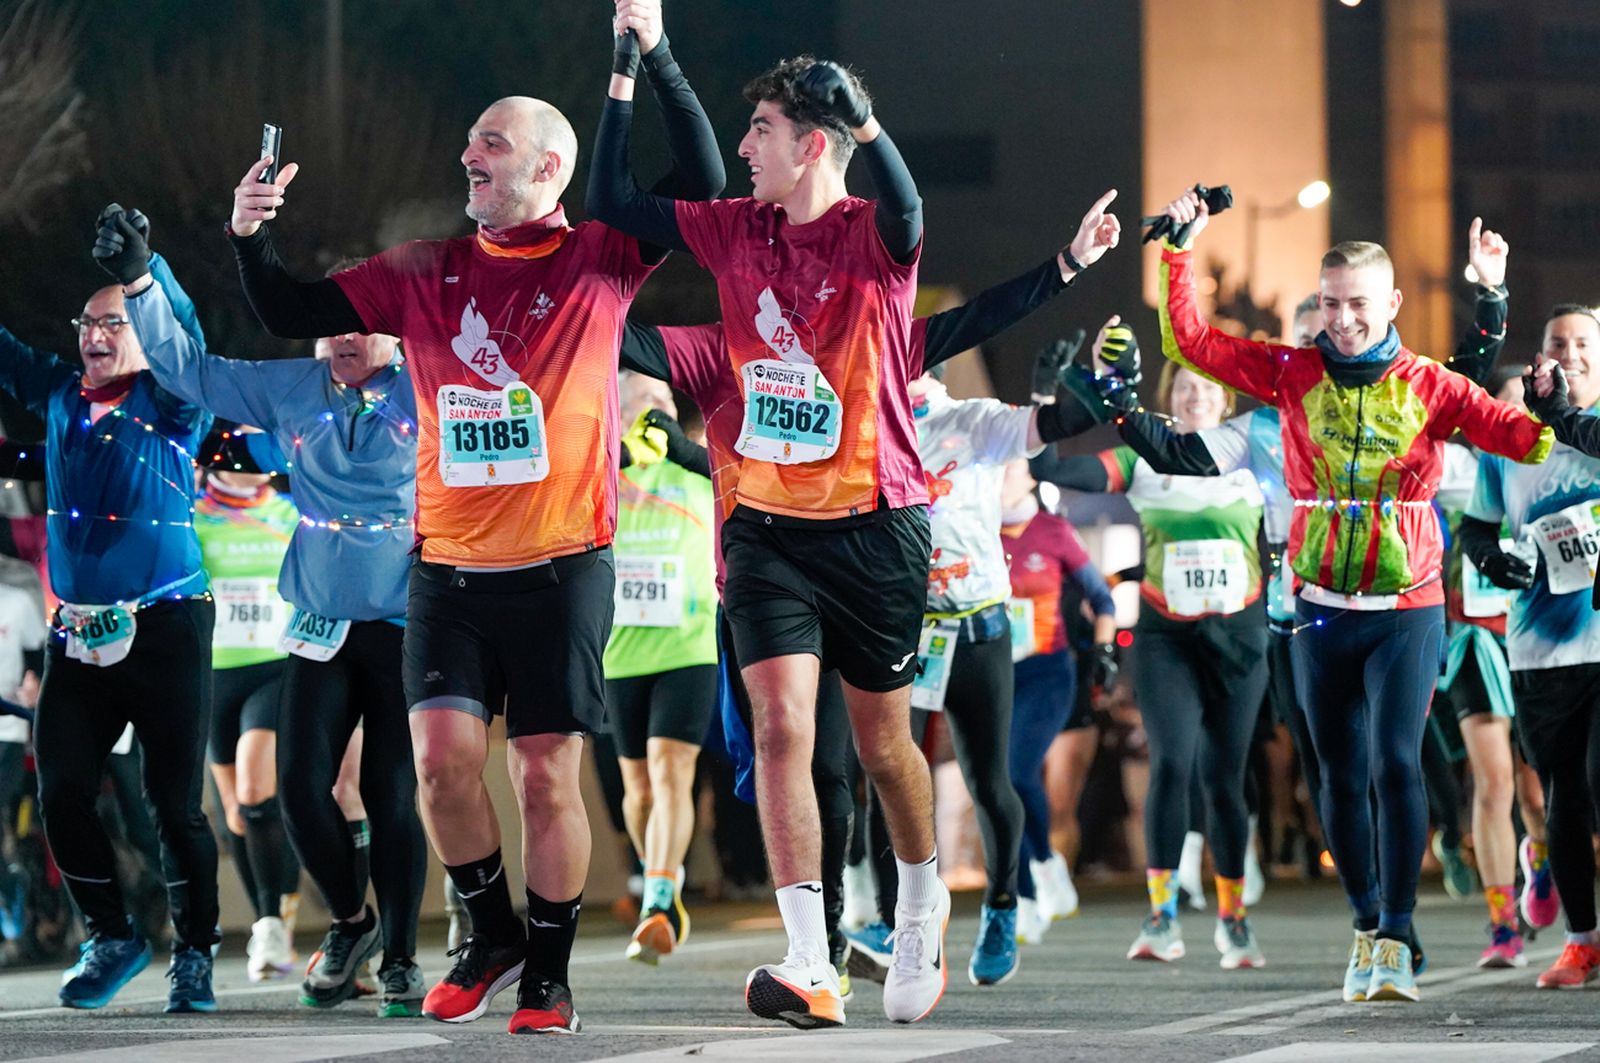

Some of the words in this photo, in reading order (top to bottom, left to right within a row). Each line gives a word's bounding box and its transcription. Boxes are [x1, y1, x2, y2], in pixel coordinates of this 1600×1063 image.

[771, 325, 795, 354] 43
[471, 347, 499, 375] 43
[765, 370, 795, 384] NOCHE
[755, 380, 772, 394] SAN
[458, 397, 489, 410] NOCHE
[491, 401, 503, 409] DE
[449, 409, 465, 419] SAN
[756, 395, 830, 435] 12562
[452, 418, 530, 452] 13185
[779, 431, 797, 441] Pedro
[479, 453, 499, 461] Pedro
[1558, 529, 1600, 564] 646
[1184, 568, 1228, 589] 1874
[622, 581, 667, 601] 6291
[229, 603, 273, 622] 7680
